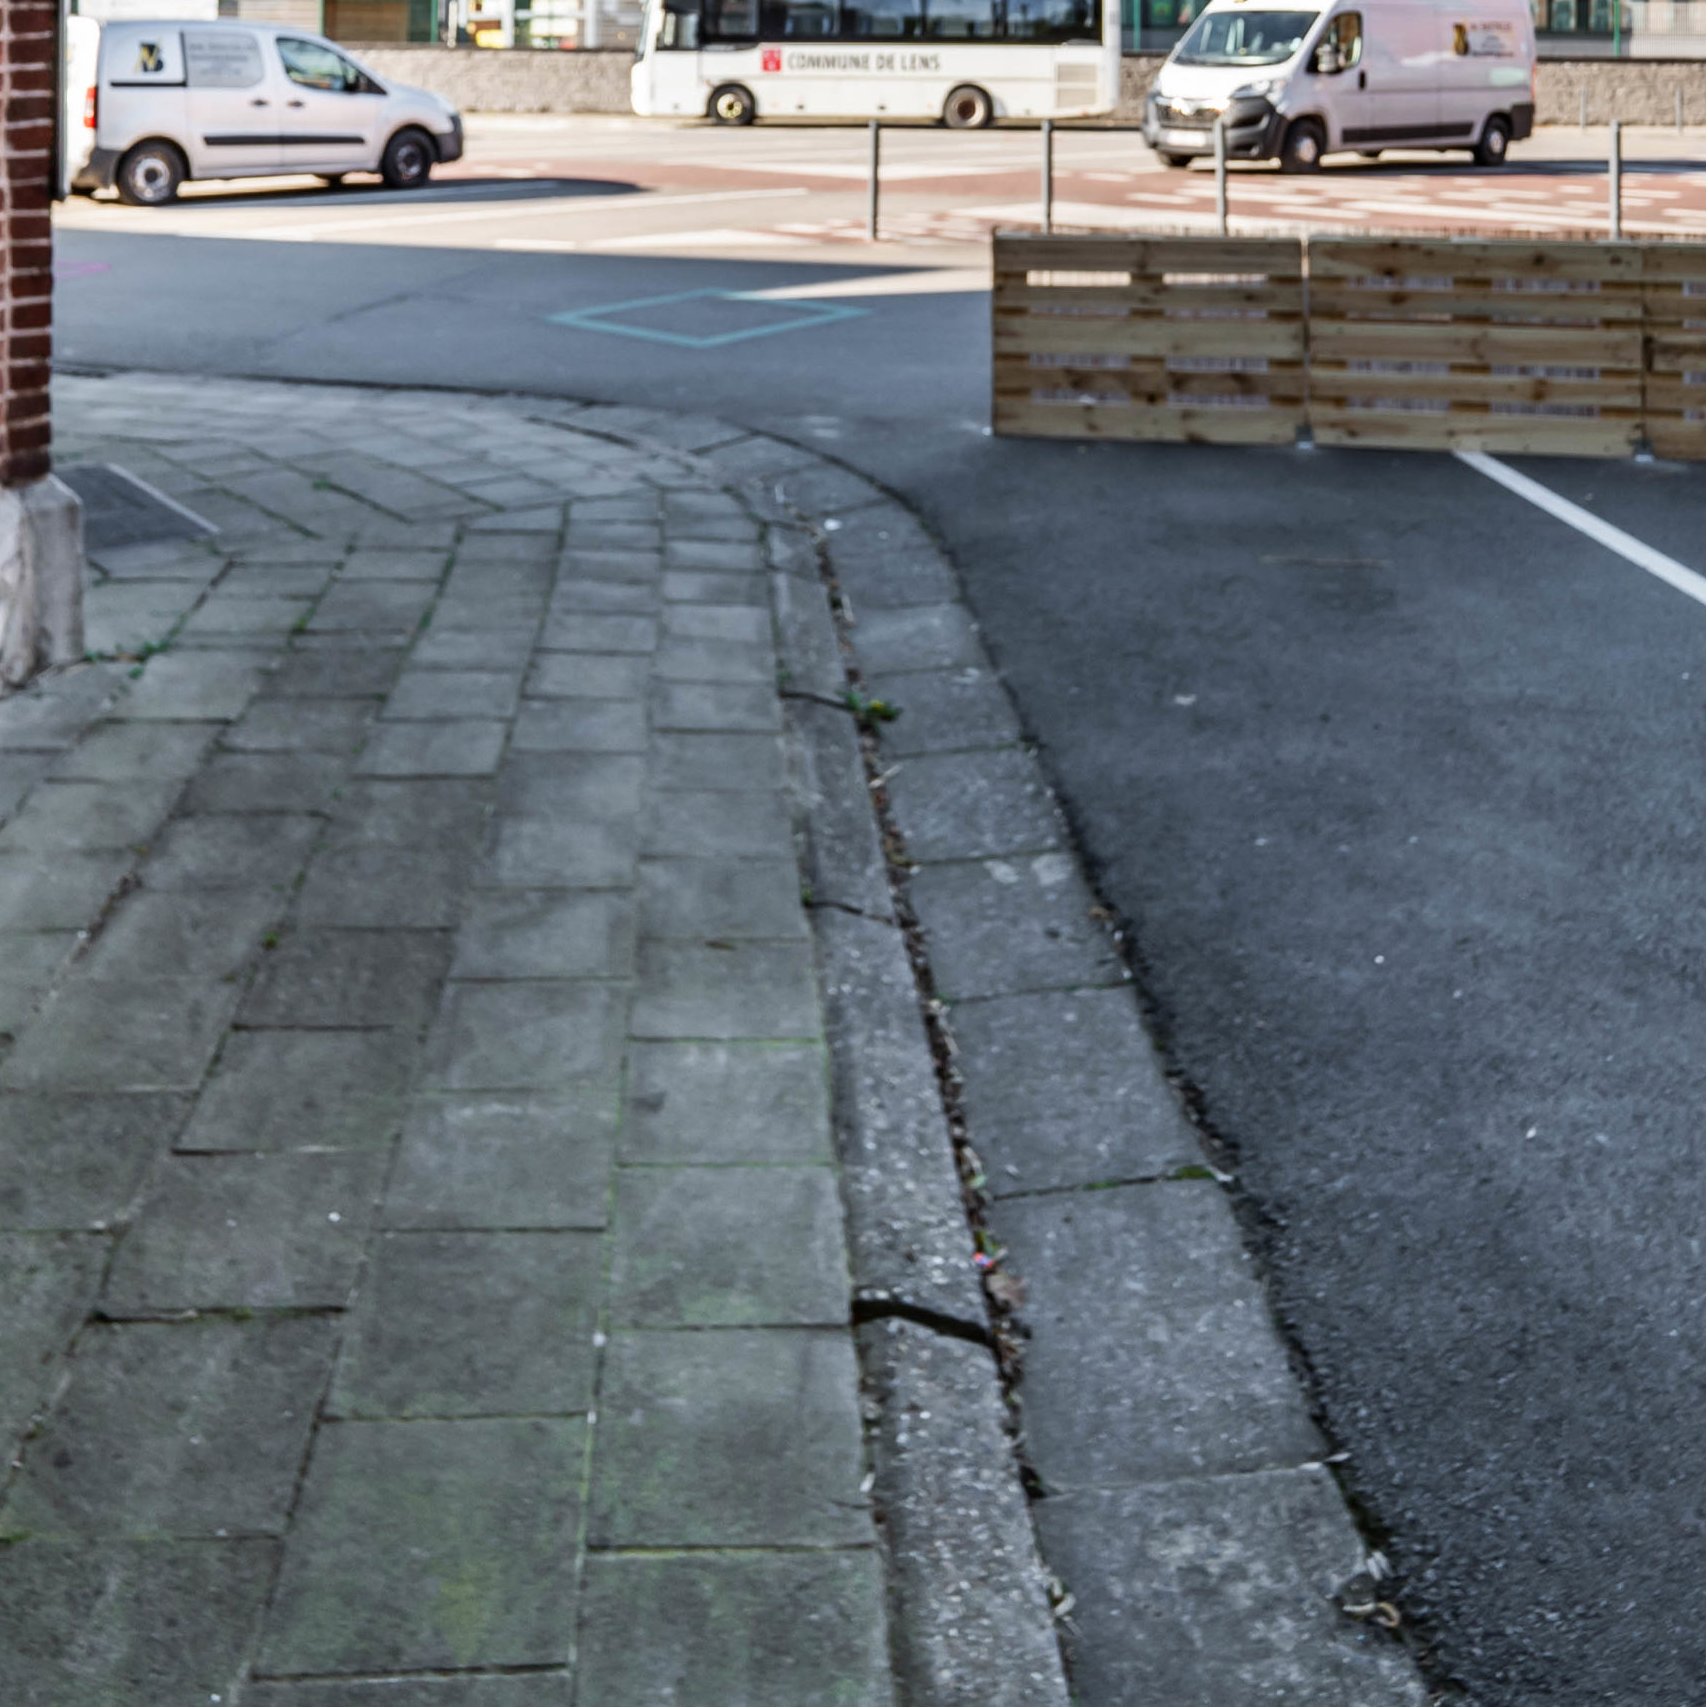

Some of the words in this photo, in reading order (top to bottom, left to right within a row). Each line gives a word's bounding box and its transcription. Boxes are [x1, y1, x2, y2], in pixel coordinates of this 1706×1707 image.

[787, 52, 870, 71] COMMUNE
[876, 52, 896, 71] DE
[900, 52, 941, 71] LENS
